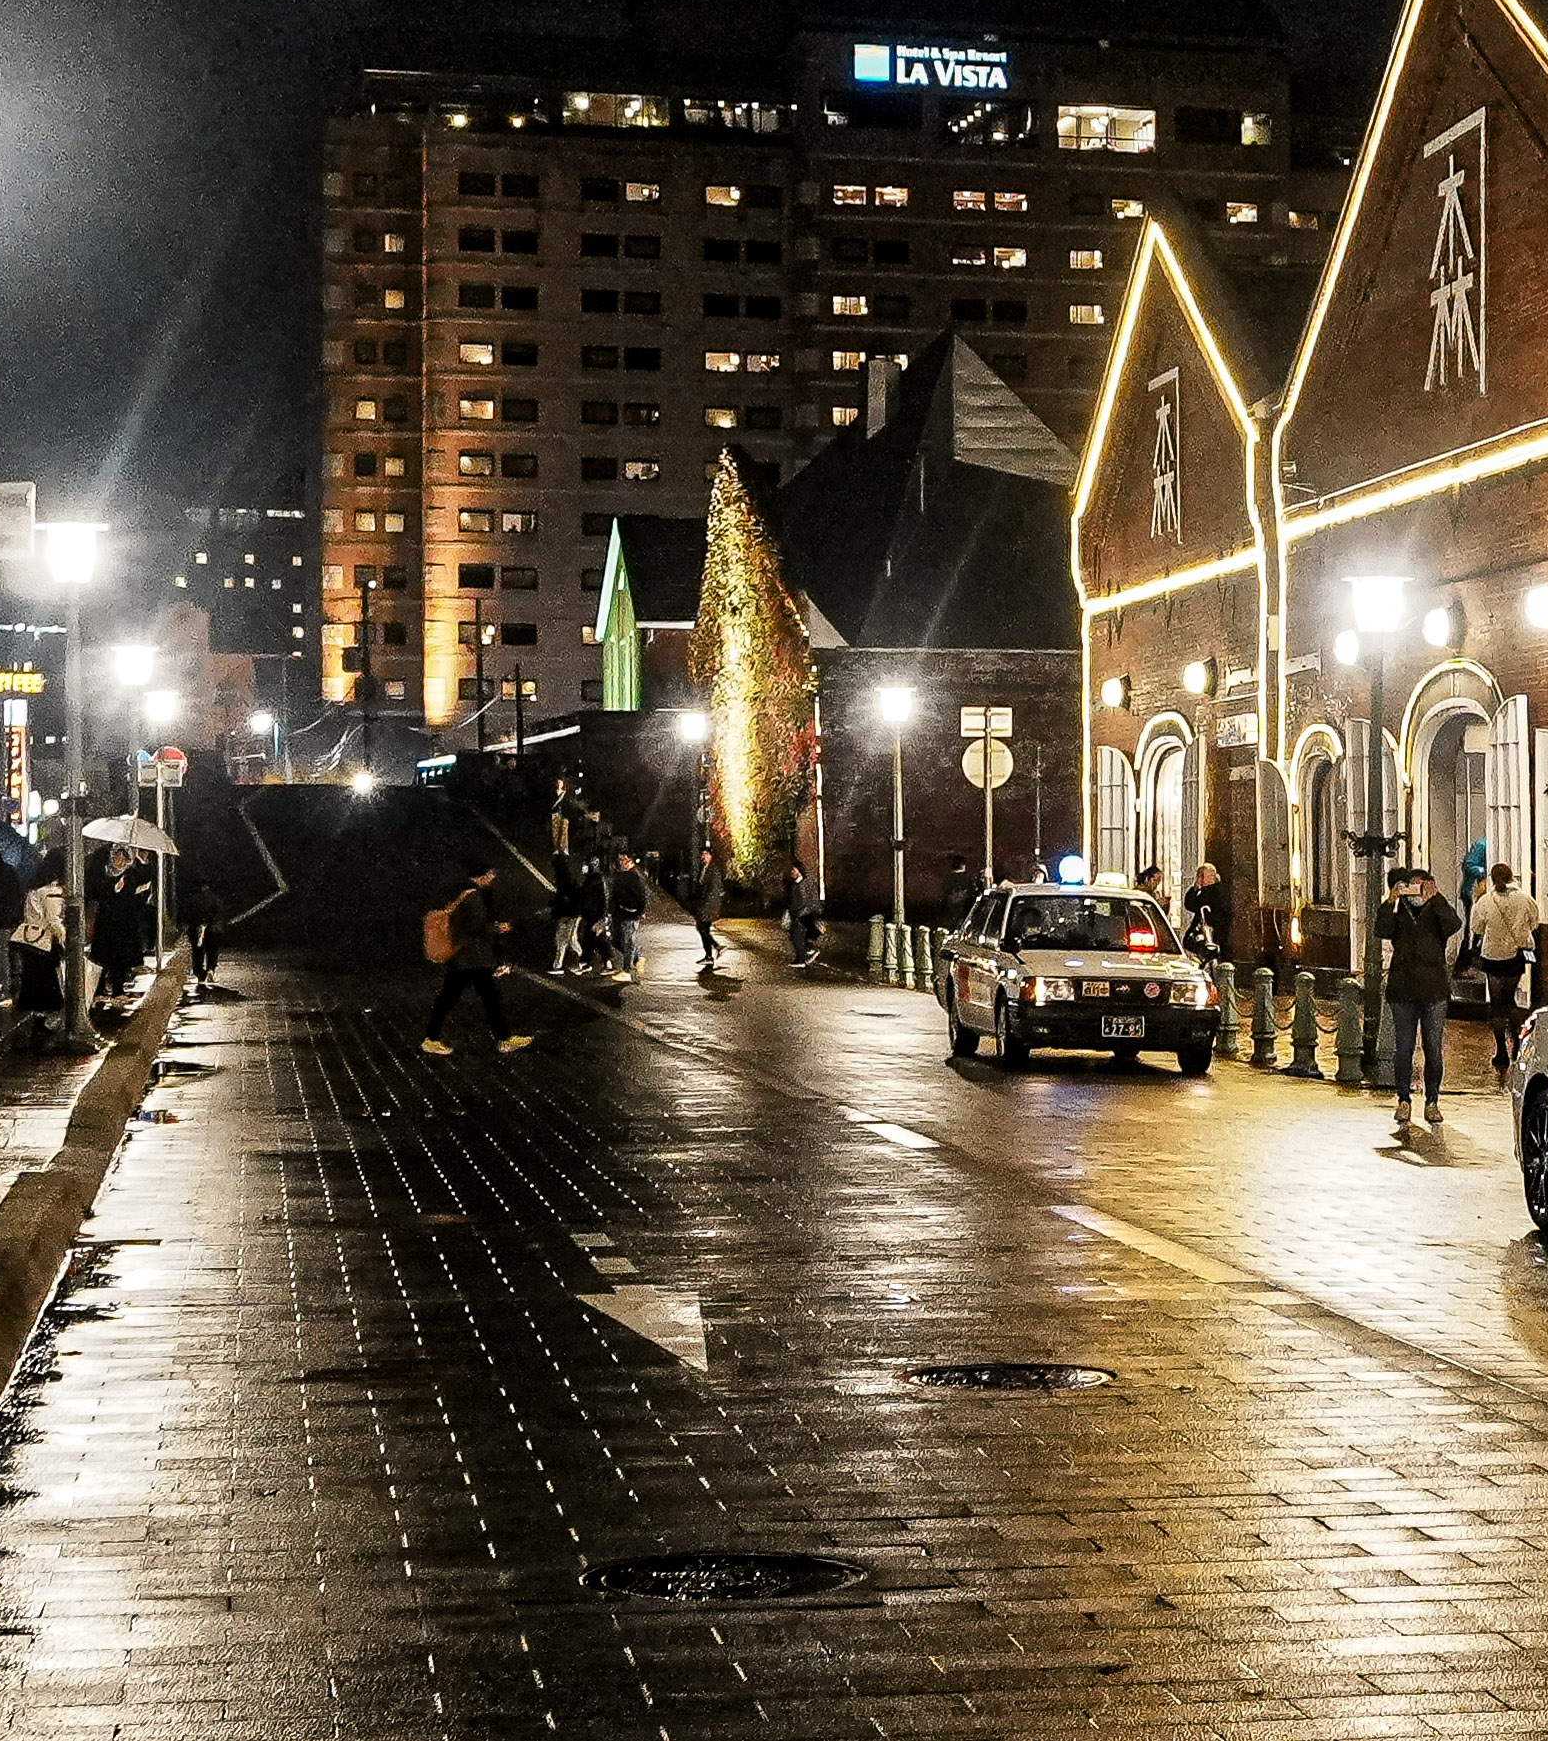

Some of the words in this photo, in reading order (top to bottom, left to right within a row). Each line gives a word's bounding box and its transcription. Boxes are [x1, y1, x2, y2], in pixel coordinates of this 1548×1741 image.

[943, 48, 965, 60] Spa
[896, 58, 929, 85] LA
[934, 60, 1008, 89] VISTA
